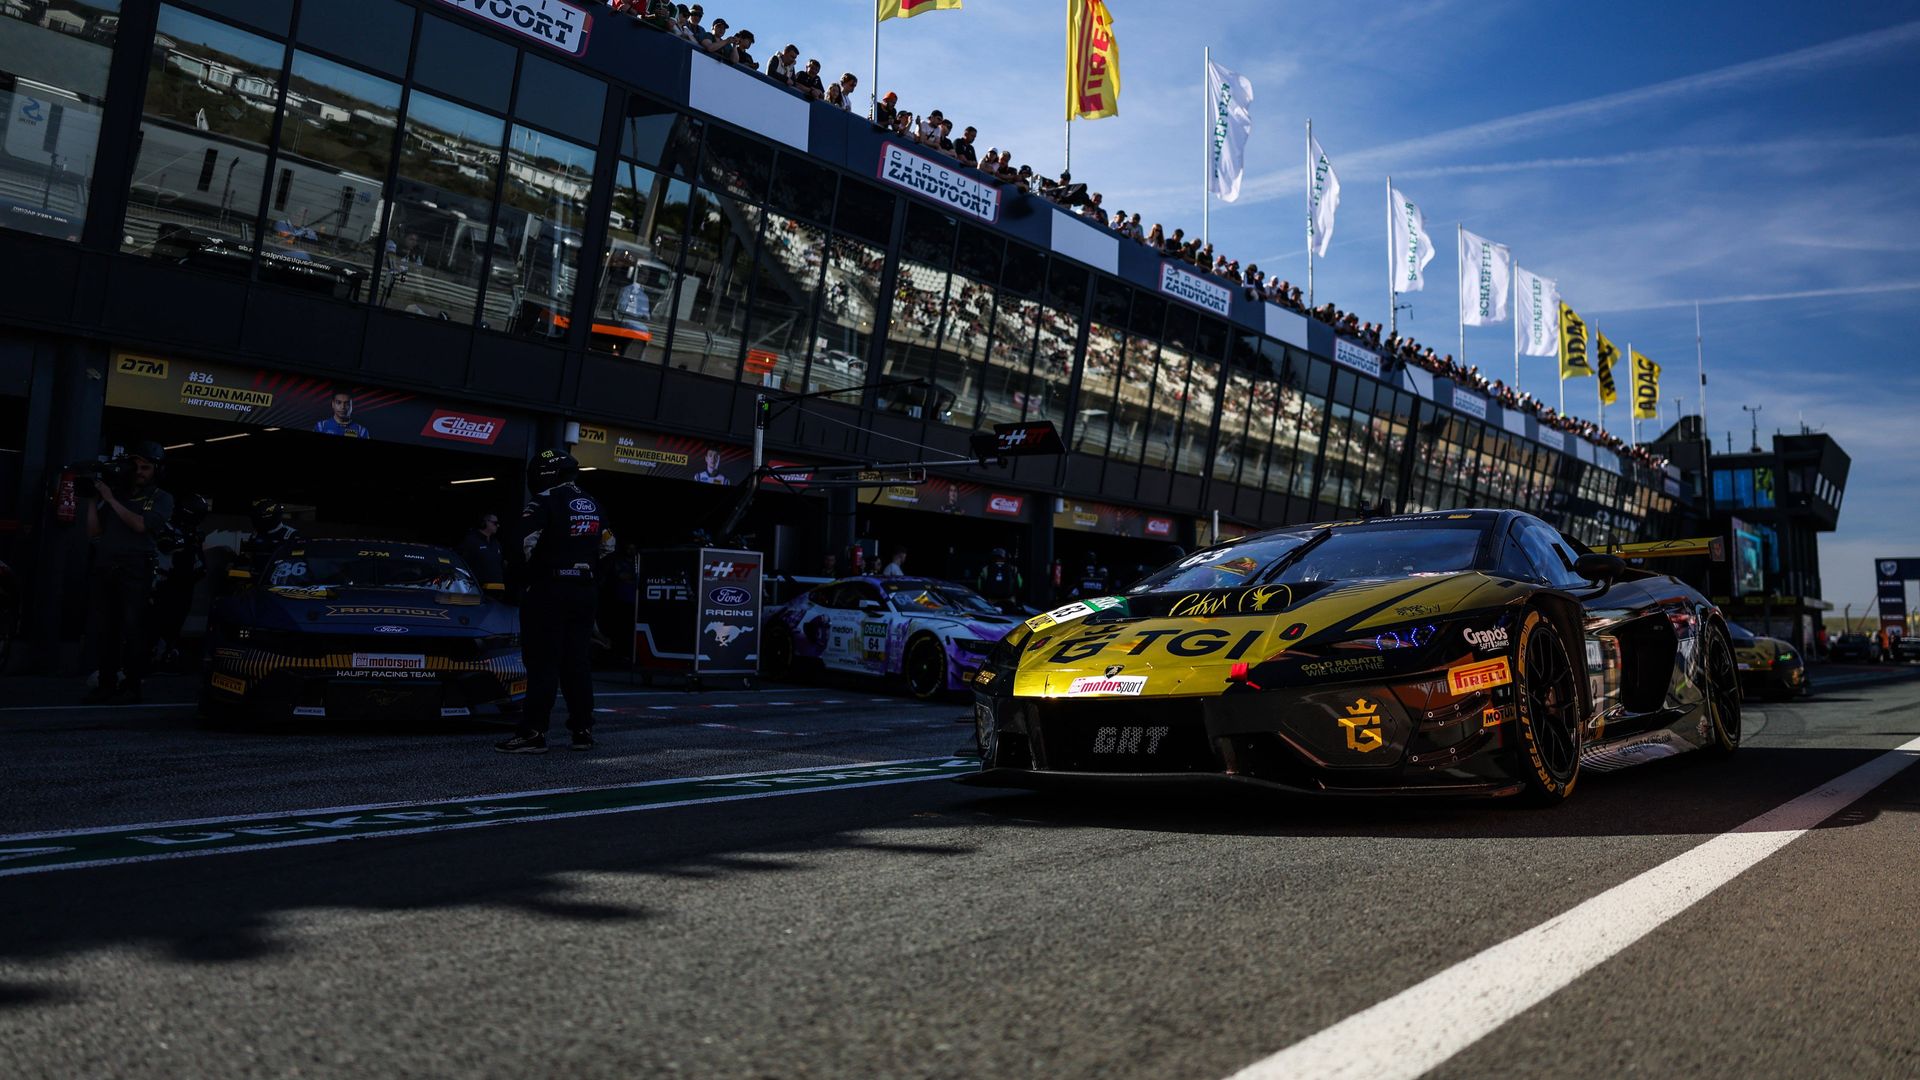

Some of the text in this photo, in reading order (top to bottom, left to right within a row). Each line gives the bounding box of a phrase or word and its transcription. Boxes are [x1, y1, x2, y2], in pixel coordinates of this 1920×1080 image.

[892, 150, 992, 198] CIRCUIT
[888, 160, 991, 216] ZANDVOORT
[1165, 276, 1227, 312] ZANDVOORT
[121, 358, 164, 375] DTM
[188, 371, 214, 384] #36
[1638, 358, 1657, 411] ADAC
[183, 384, 270, 405] ARJUN MAINI
[187, 397, 252, 413] HRT FORD RACING
[432, 416, 496, 434] Eibach
[615, 447, 687, 464] FINN WIEBELHAUS
[1368, 514, 1441, 524] BORTOLOTTI
[716, 588, 743, 603] Ford
[340, 606, 438, 616] RAVENOL
[705, 608, 754, 617] RACING
[864, 623, 886, 635] DEKRA
[868, 638, 879, 650] 64
[1127, 628, 1265, 660] TGI
[369, 654, 421, 669] motorsport
[1300, 655, 1385, 672] GOLD RABATTE
[372, 670, 411, 678] RACING
[1305, 668, 1329, 677] WIE
[1329, 665, 1364, 675] NOCH
[1454, 662, 1507, 690] PIRELLI
[1080, 677, 1144, 694] motorsport
[1485, 705, 1515, 724] MOTUL
[126, 804, 550, 846] DEKRA
